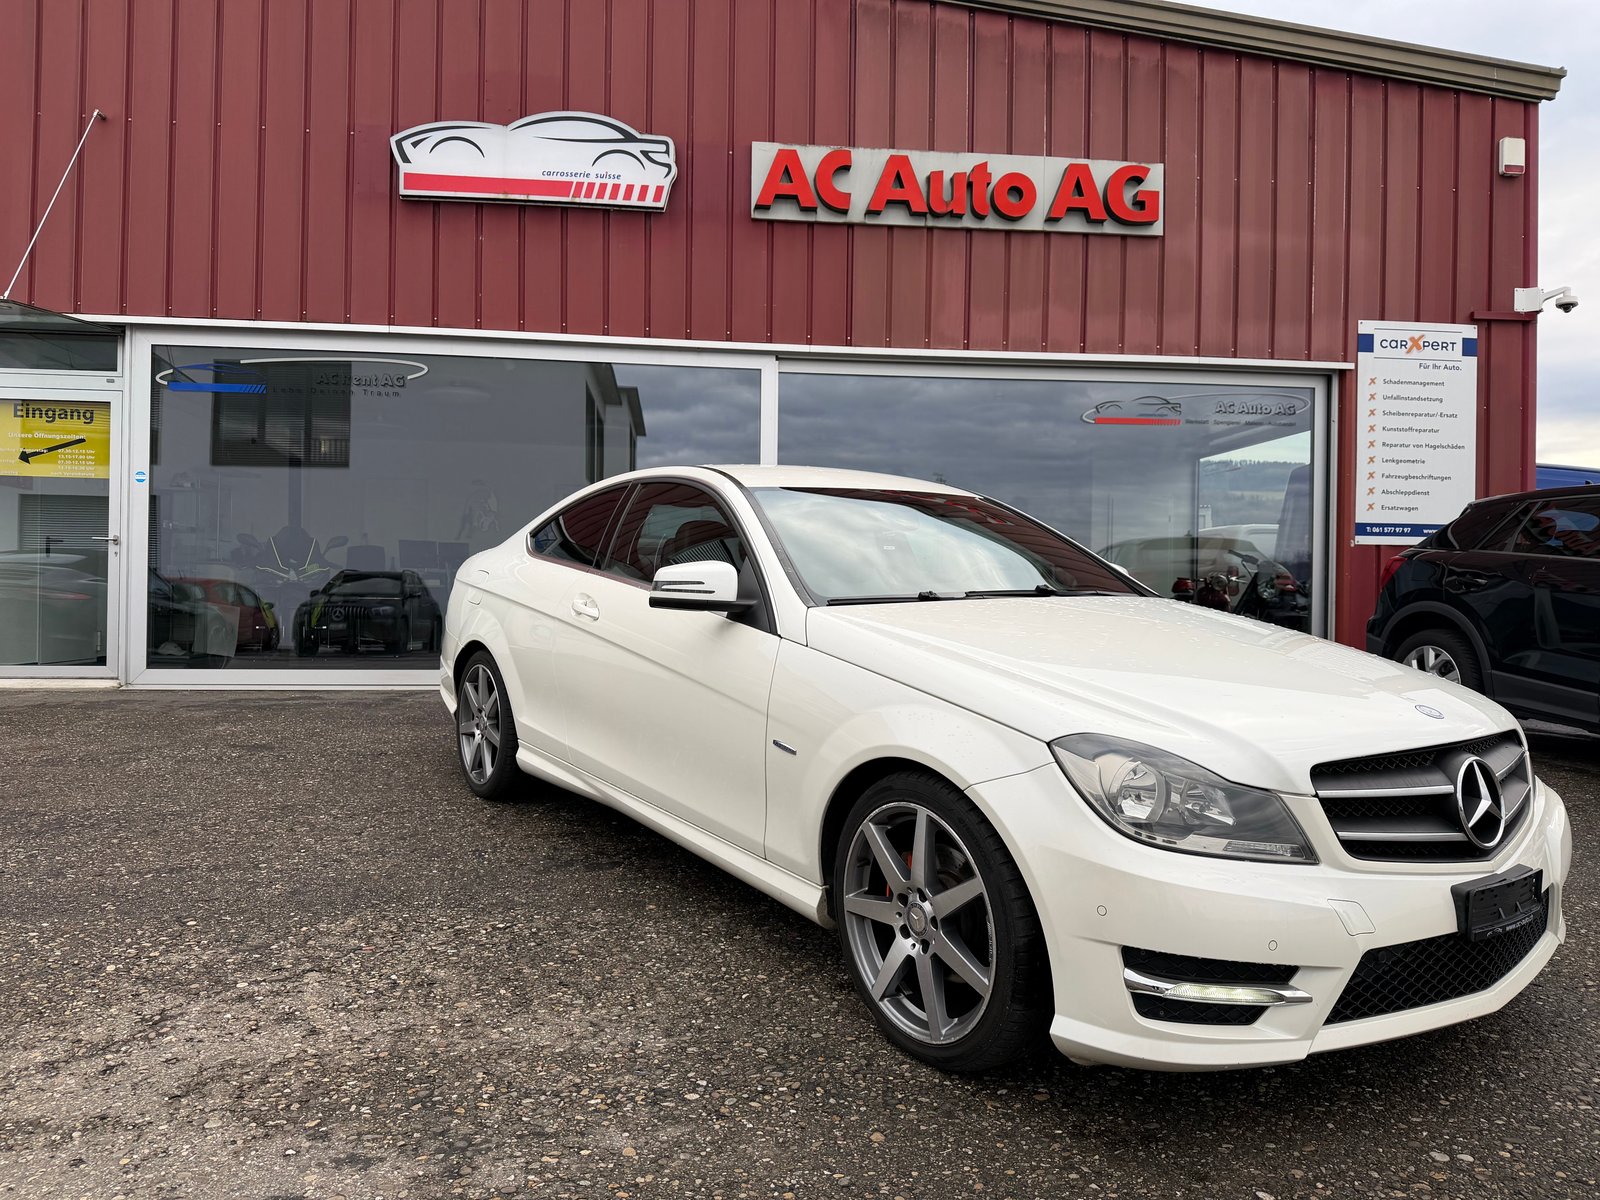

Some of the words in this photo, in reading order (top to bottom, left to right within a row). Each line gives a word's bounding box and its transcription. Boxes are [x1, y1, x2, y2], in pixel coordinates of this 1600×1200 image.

[541, 170, 591, 179] carrosserie
[595, 171, 622, 180] suisse
[754, 148, 852, 213] AC
[864, 153, 1037, 222] Auto
[1045, 162, 1160, 226] AG
[1419, 362, 1430, 370] Für
[380, 373, 405, 388] AG
[1382, 378, 1445, 387] Schadenmanagement
[1382, 394, 1444, 403] Unfallinstandsetzung
[1215, 400, 1236, 414] AC
[1239, 401, 1272, 415] Auto
[1274, 402, 1296, 416] AG
[13, 402, 95, 425] Eingang
[1382, 425, 1441, 434] Kunststoffreparatur
[8, 431, 32, 439] Unsere
[1381, 441, 1411, 449] Reparatur
[1424, 442, 1466, 451] Hagelschäden
[1381, 457, 1426, 465] Lenkgeometrie
[1381, 473, 1452, 481] Fahrzeugbeschriftungen
[1381, 488, 1430, 497] Abschleppdienst
[1381, 504, 1419, 512] Ersatzwagen
